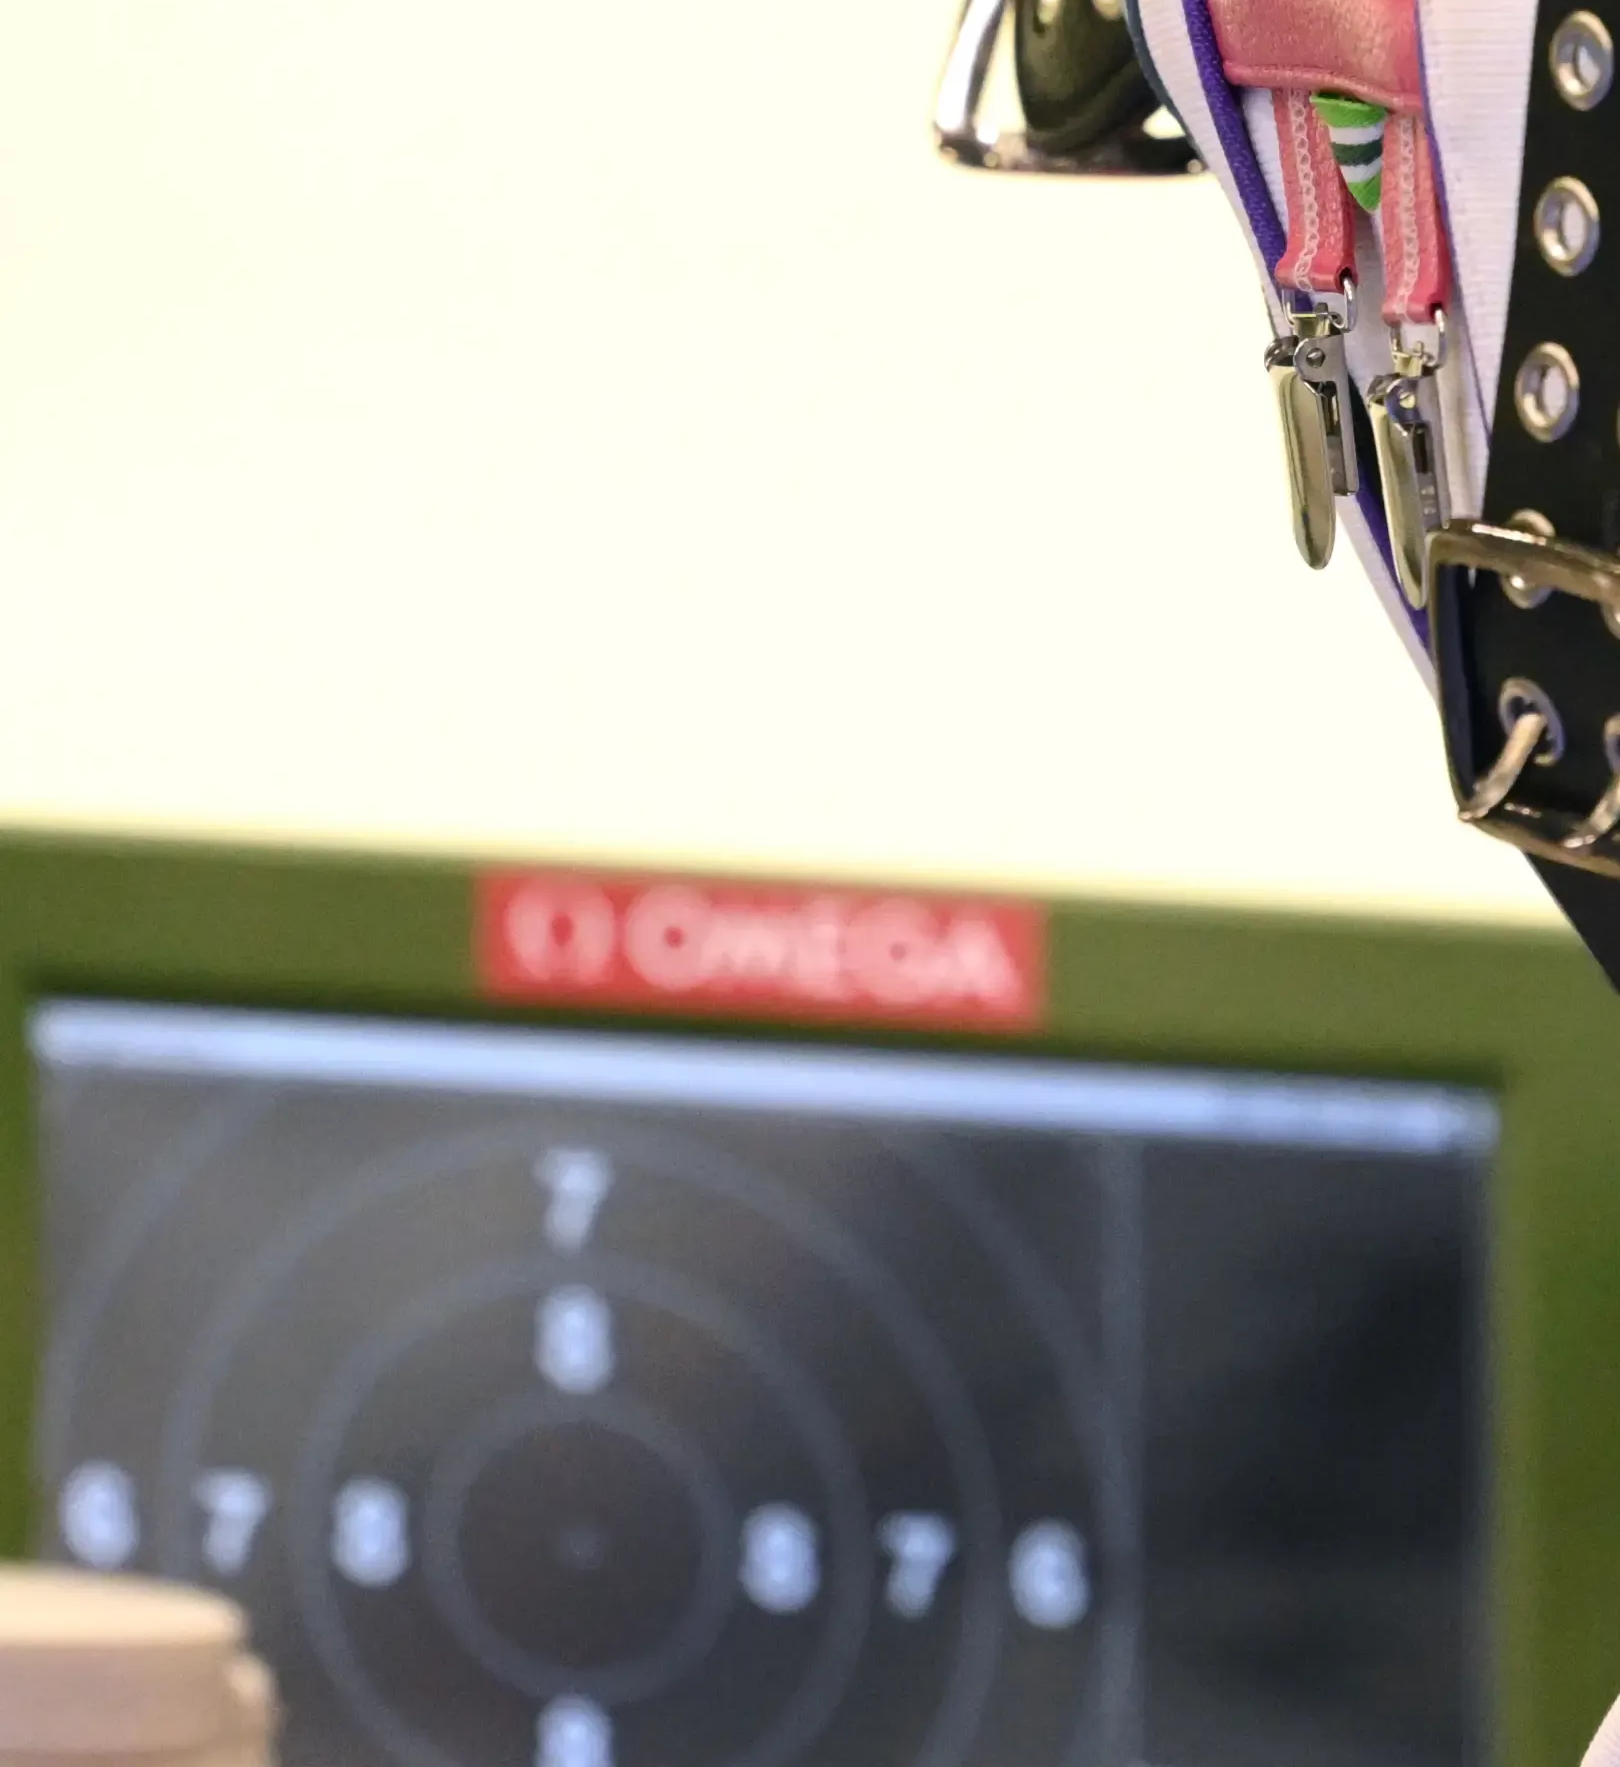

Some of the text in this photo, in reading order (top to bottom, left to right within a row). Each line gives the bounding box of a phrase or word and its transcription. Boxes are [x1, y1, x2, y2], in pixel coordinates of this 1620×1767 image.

[624, 883, 1024, 1009] OMEGA
[534, 1145, 610, 1249] 7
[536, 1285, 611, 1393] 8
[196, 1472, 268, 1571] 7
[332, 1478, 408, 1585] 8
[740, 1506, 818, 1613] 8
[882, 1514, 953, 1617] 7
